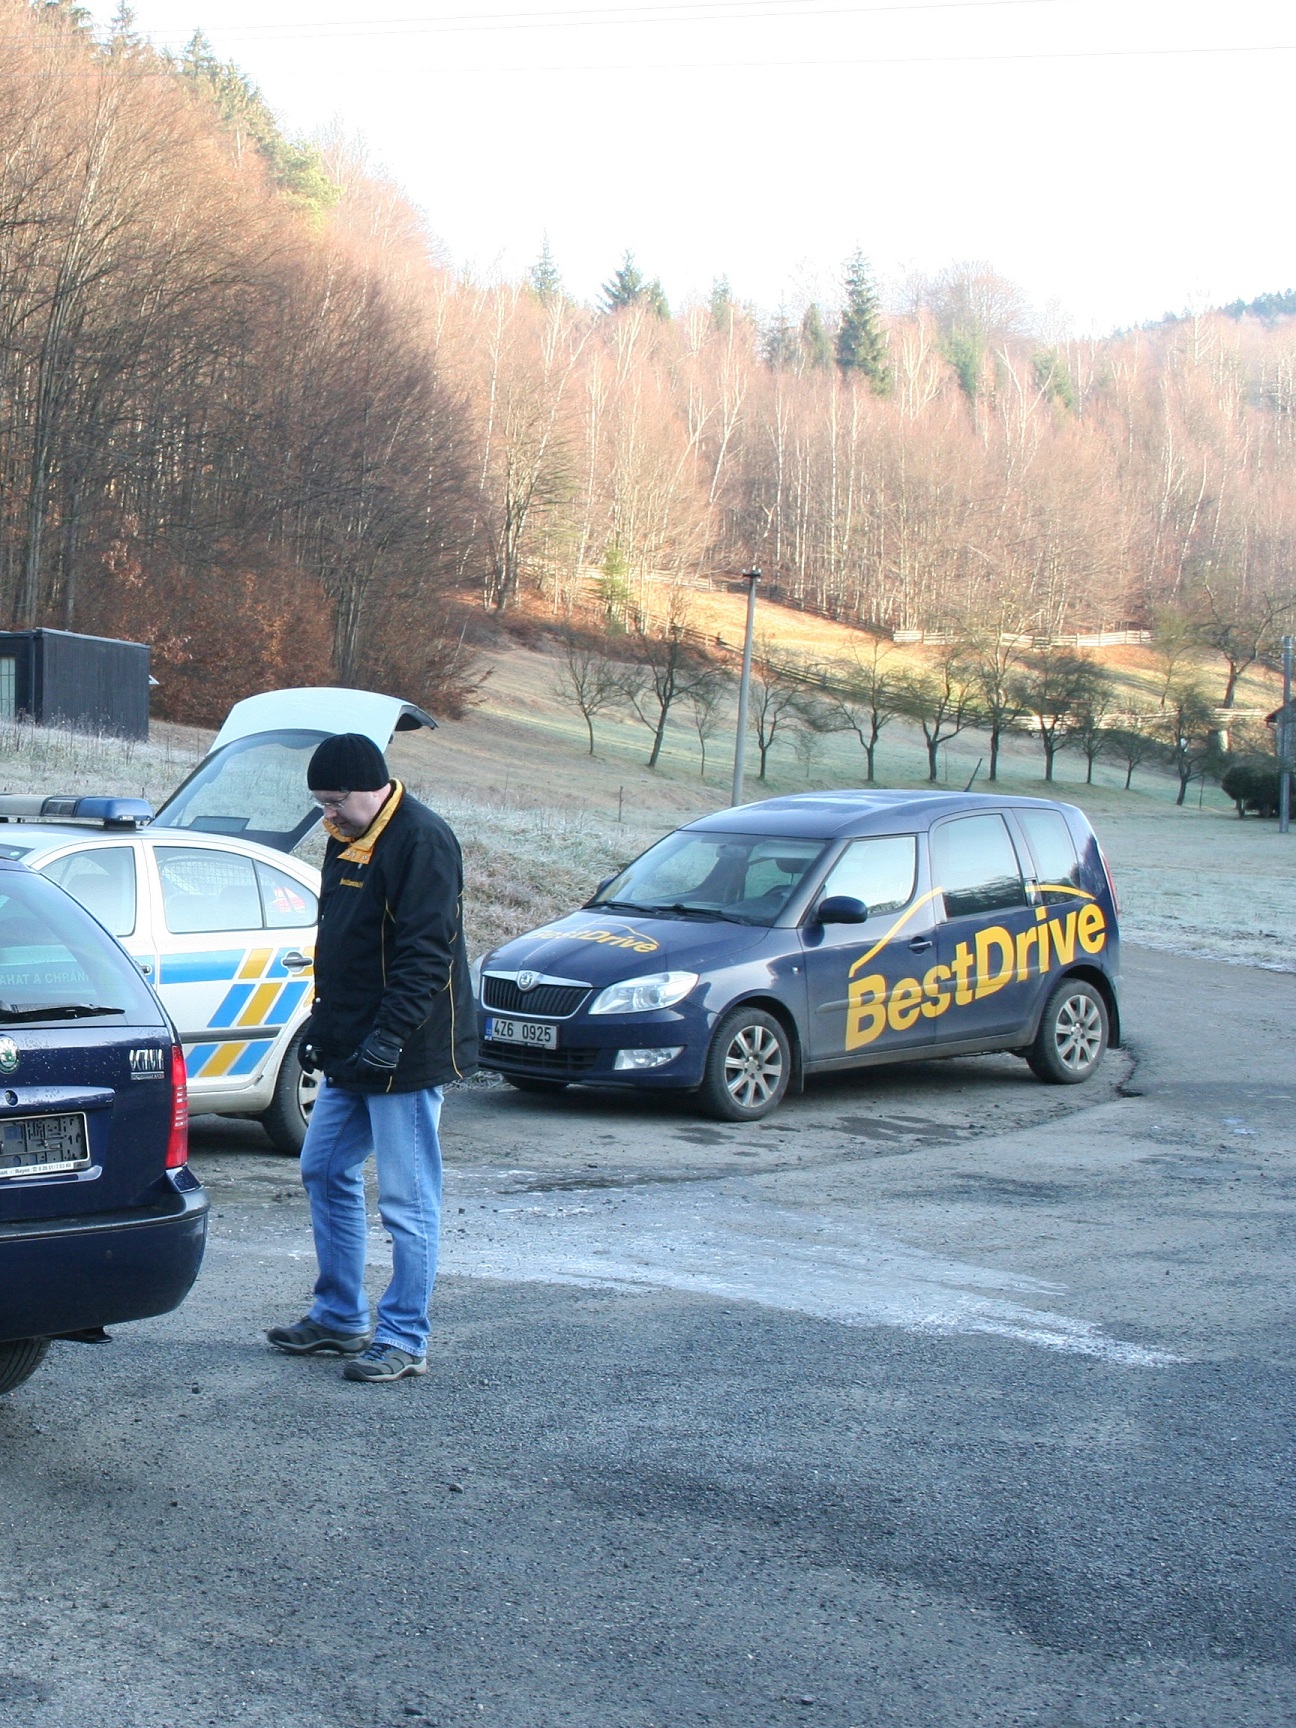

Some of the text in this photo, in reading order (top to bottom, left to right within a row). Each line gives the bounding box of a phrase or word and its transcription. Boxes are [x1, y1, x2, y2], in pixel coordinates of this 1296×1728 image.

[845, 903, 1106, 1051] BestDrive
[494, 1020, 552, 1042] 4Z6 0925
